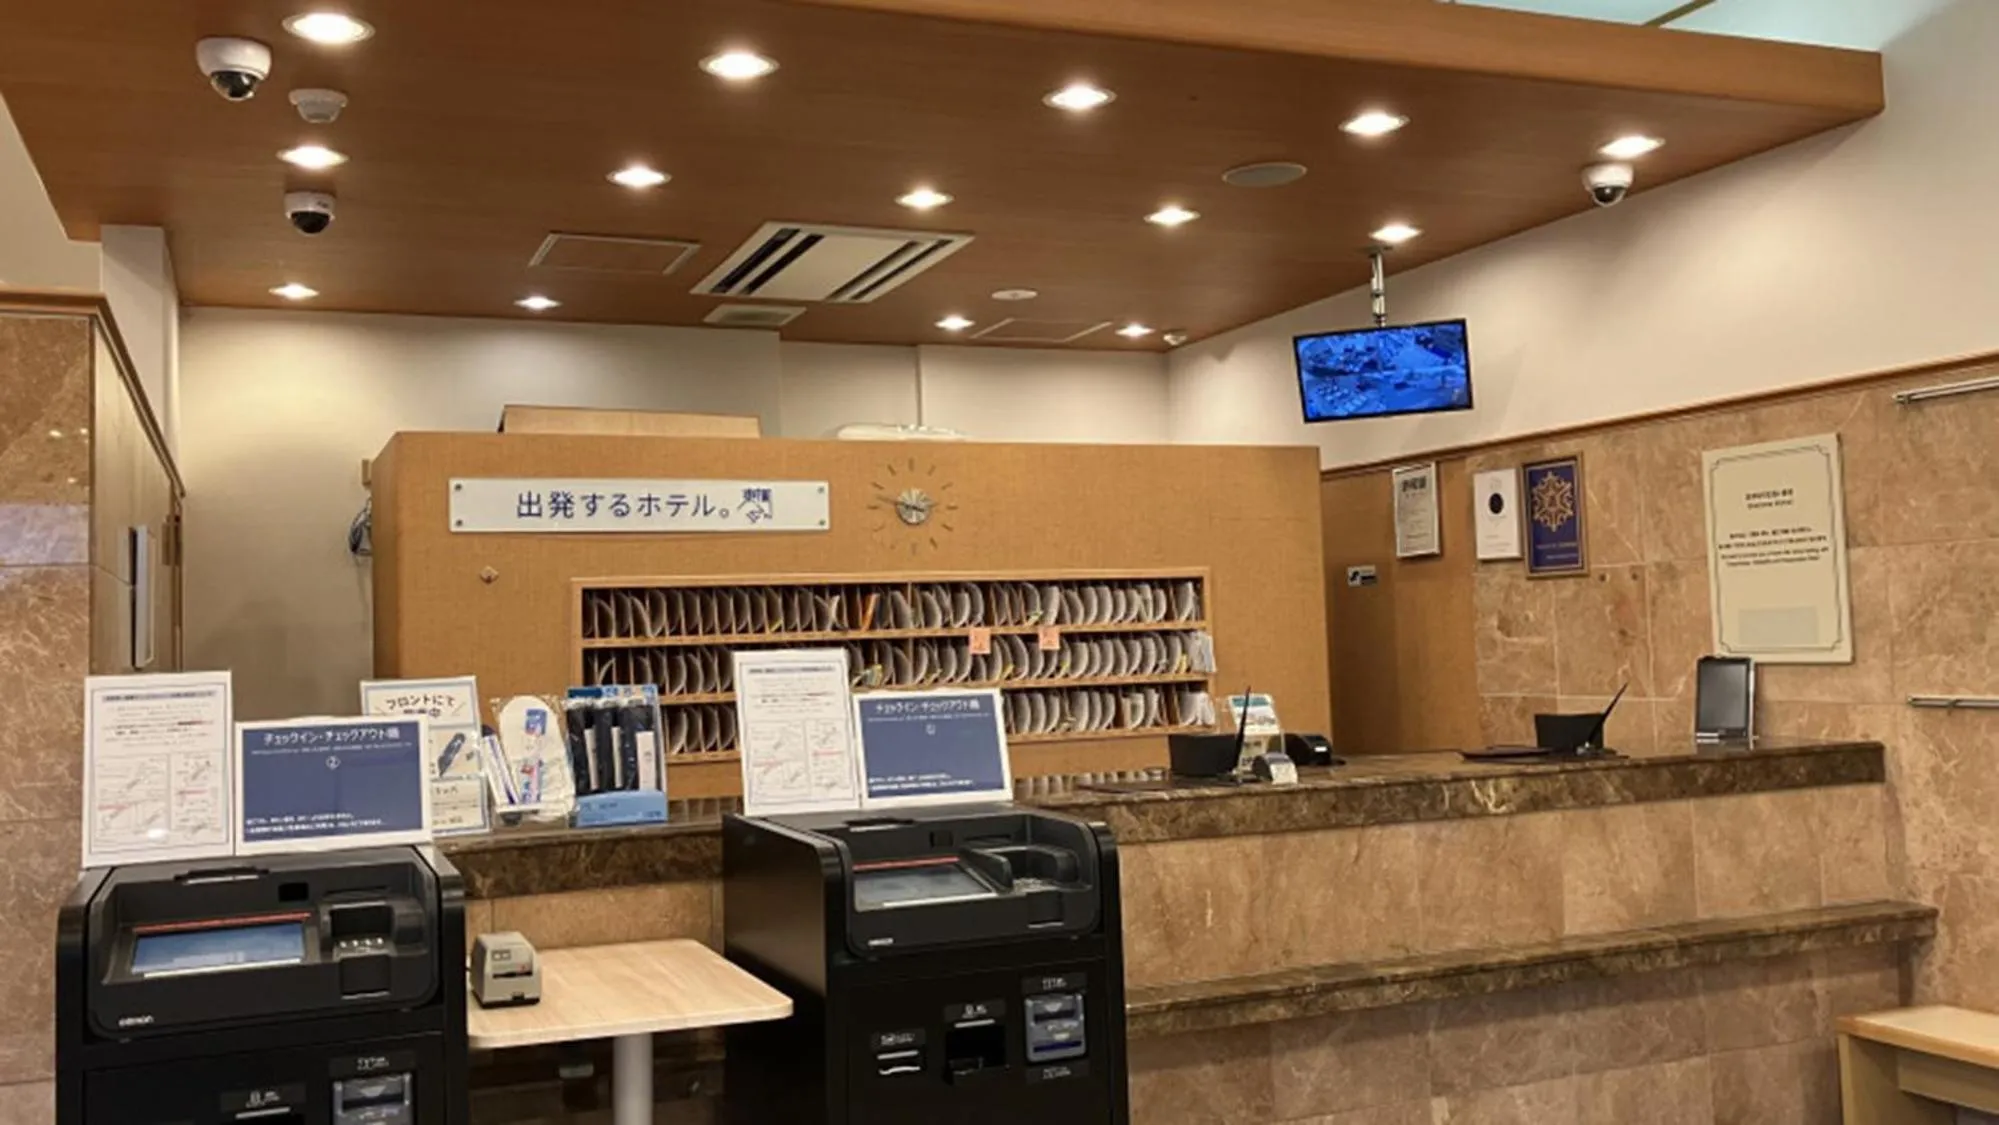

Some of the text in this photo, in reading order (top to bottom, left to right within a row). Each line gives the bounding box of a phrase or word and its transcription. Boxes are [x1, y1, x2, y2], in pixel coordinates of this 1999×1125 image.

[516, 490, 730, 519] 出発するホテル。
[385, 693, 456, 710] フロントにて
[263, 727, 400, 746] チェックイン・チェックアウト機
